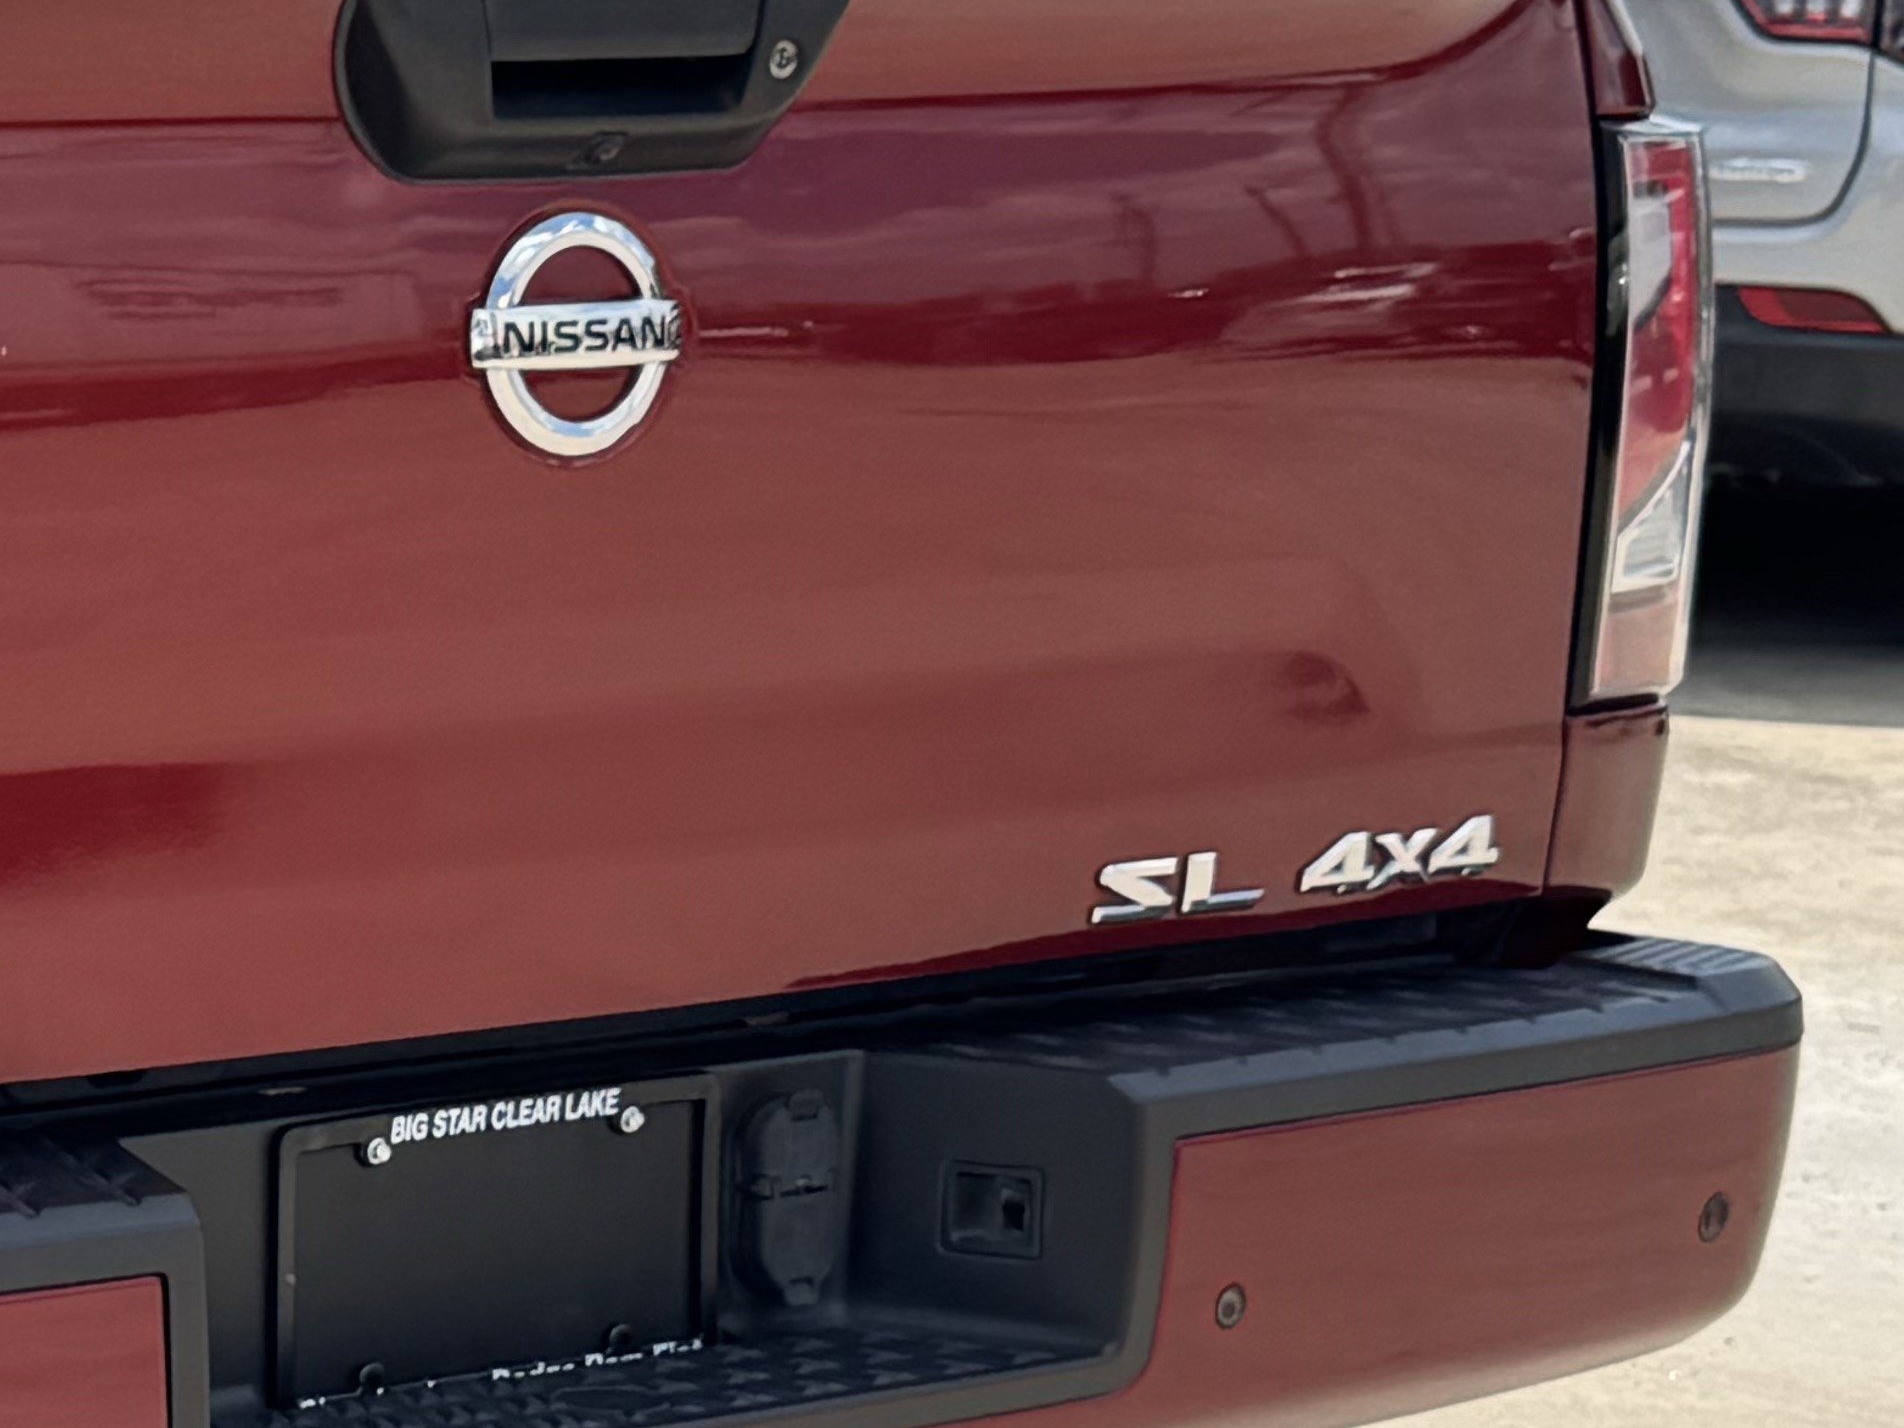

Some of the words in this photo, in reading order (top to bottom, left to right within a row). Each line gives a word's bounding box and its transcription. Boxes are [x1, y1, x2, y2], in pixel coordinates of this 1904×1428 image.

[502, 315, 667, 355] NISSAN
[1091, 851, 1265, 924] SL
[391, 1112, 429, 1145] BIG
[432, 1104, 489, 1139] STAR
[491, 1094, 562, 1131] CLEAR
[564, 1086, 622, 1121] LAKE
